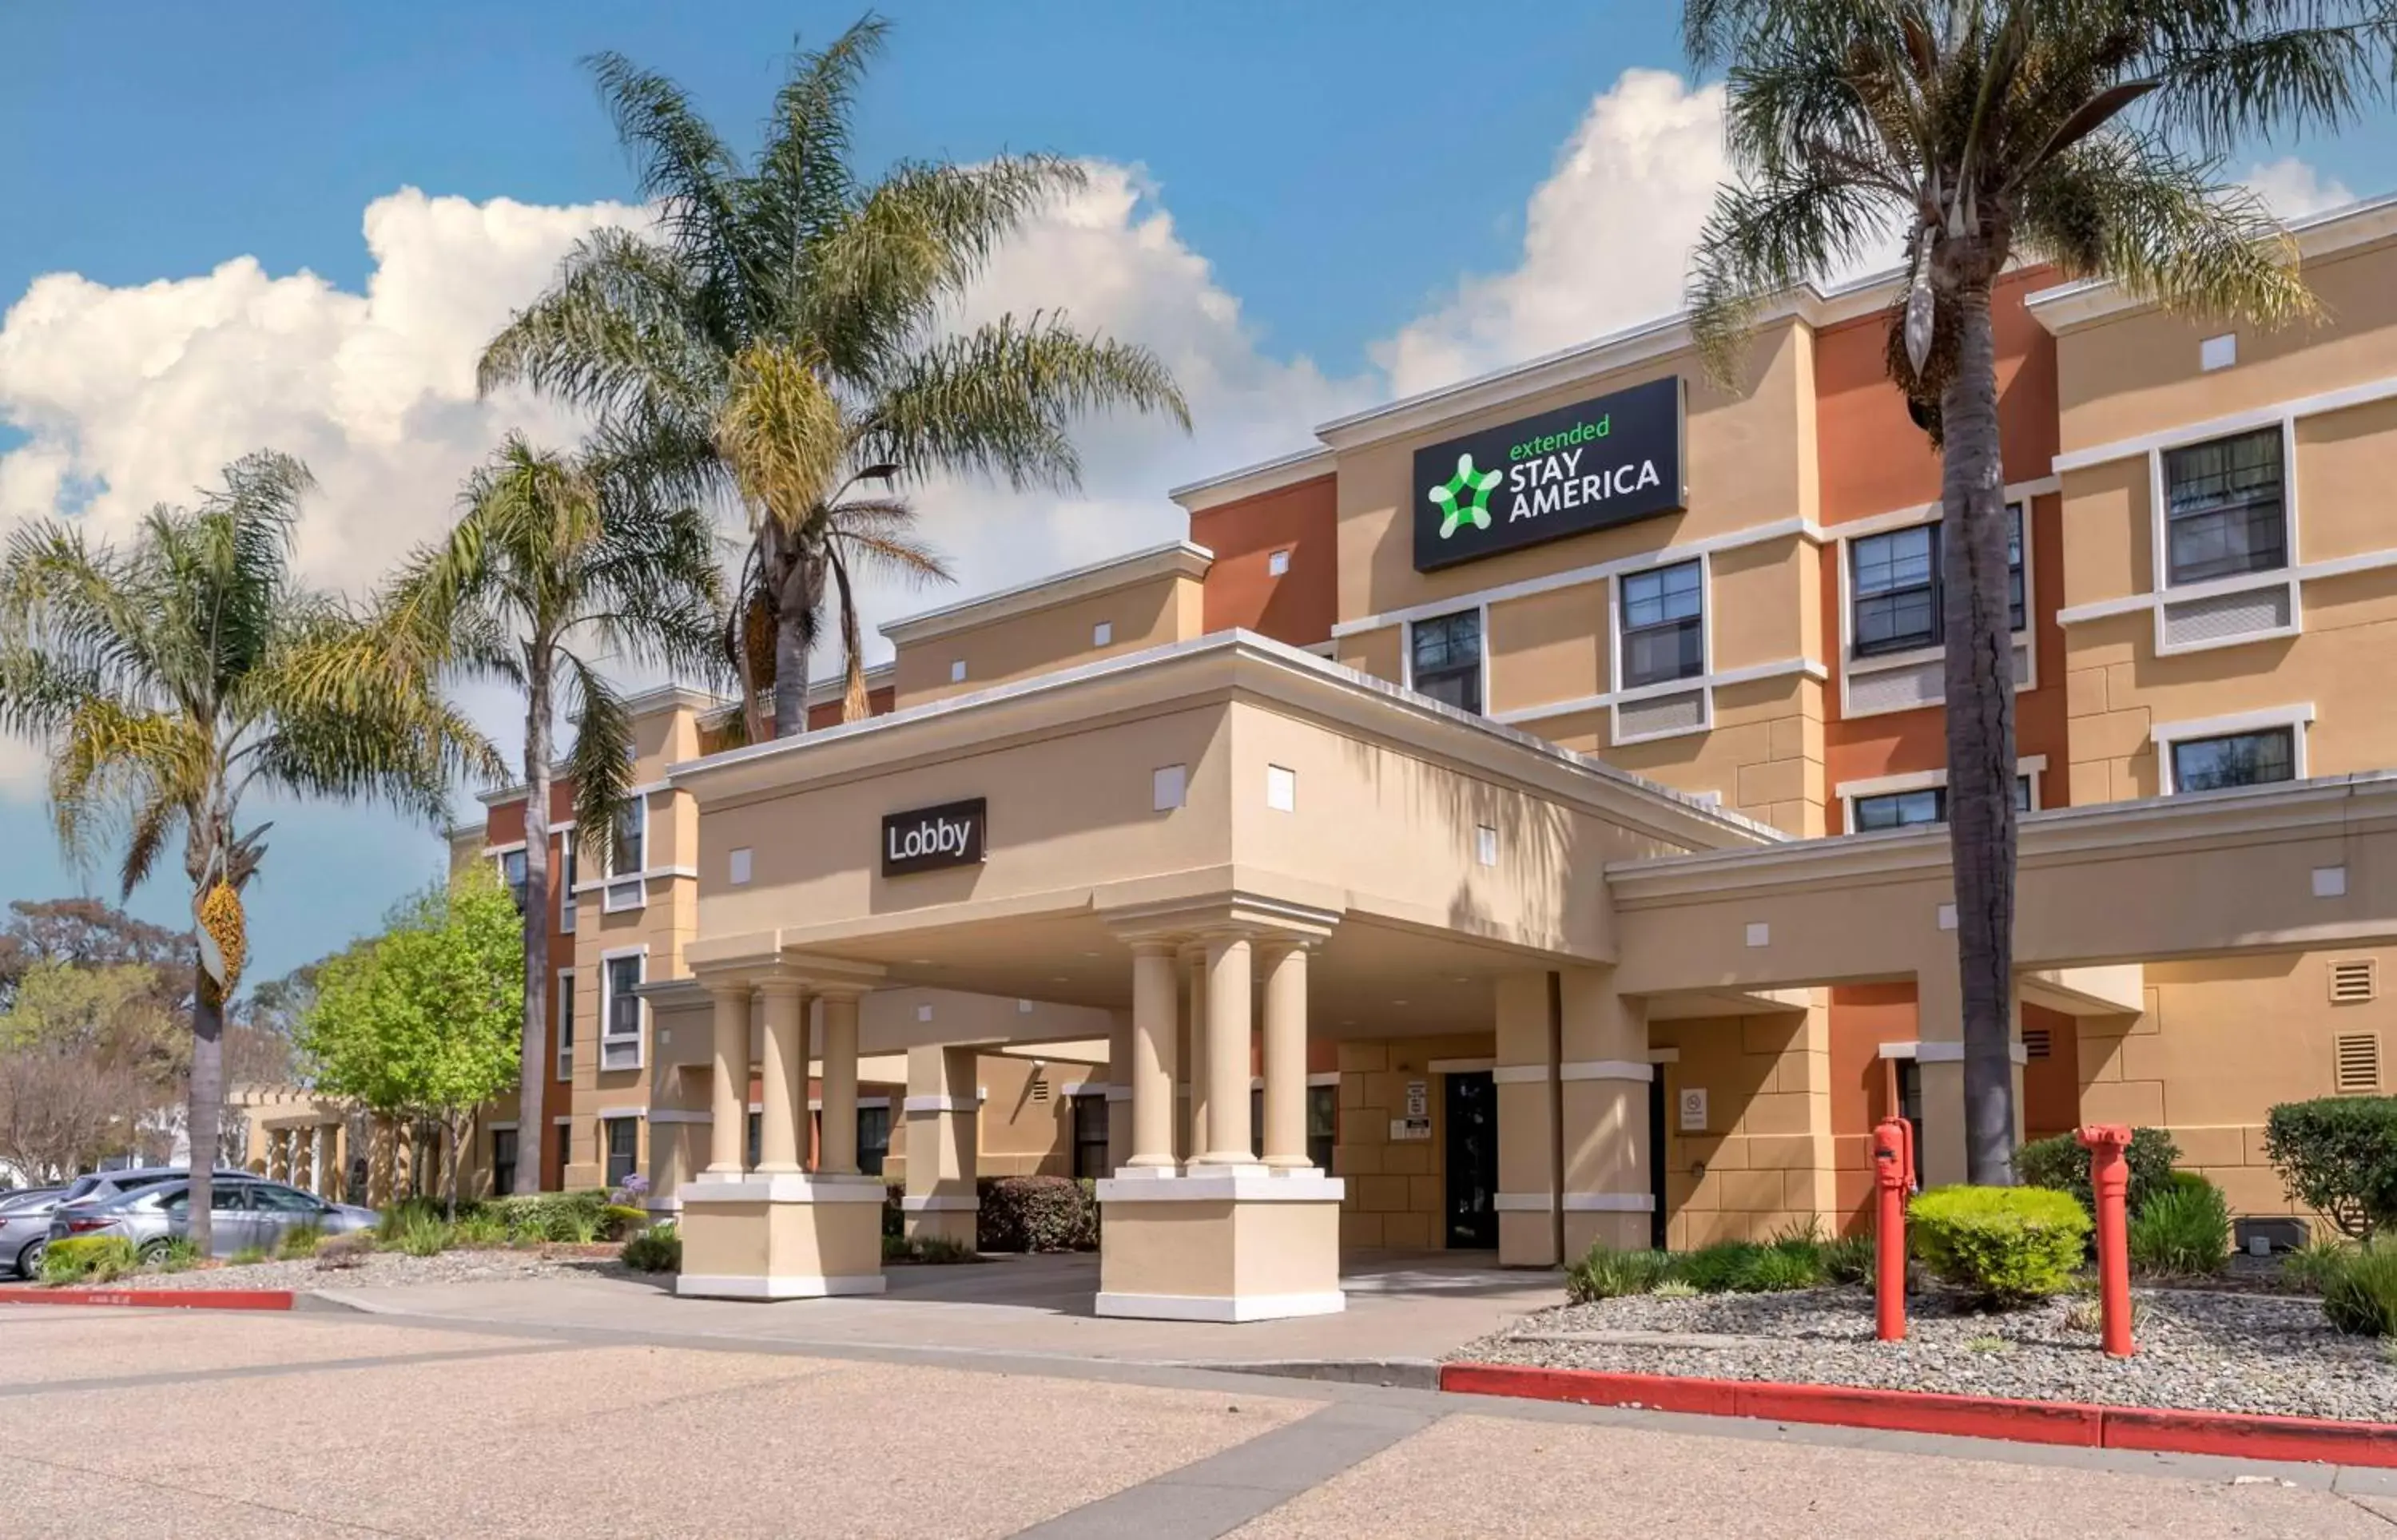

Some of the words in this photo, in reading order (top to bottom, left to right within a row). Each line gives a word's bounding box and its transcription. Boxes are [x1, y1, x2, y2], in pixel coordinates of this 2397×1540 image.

[1509, 414, 1610, 461] extended
[1509, 448, 1583, 493] STAY
[1509, 459, 1660, 523] AMERICA
[889, 817, 971, 860] Lobby
